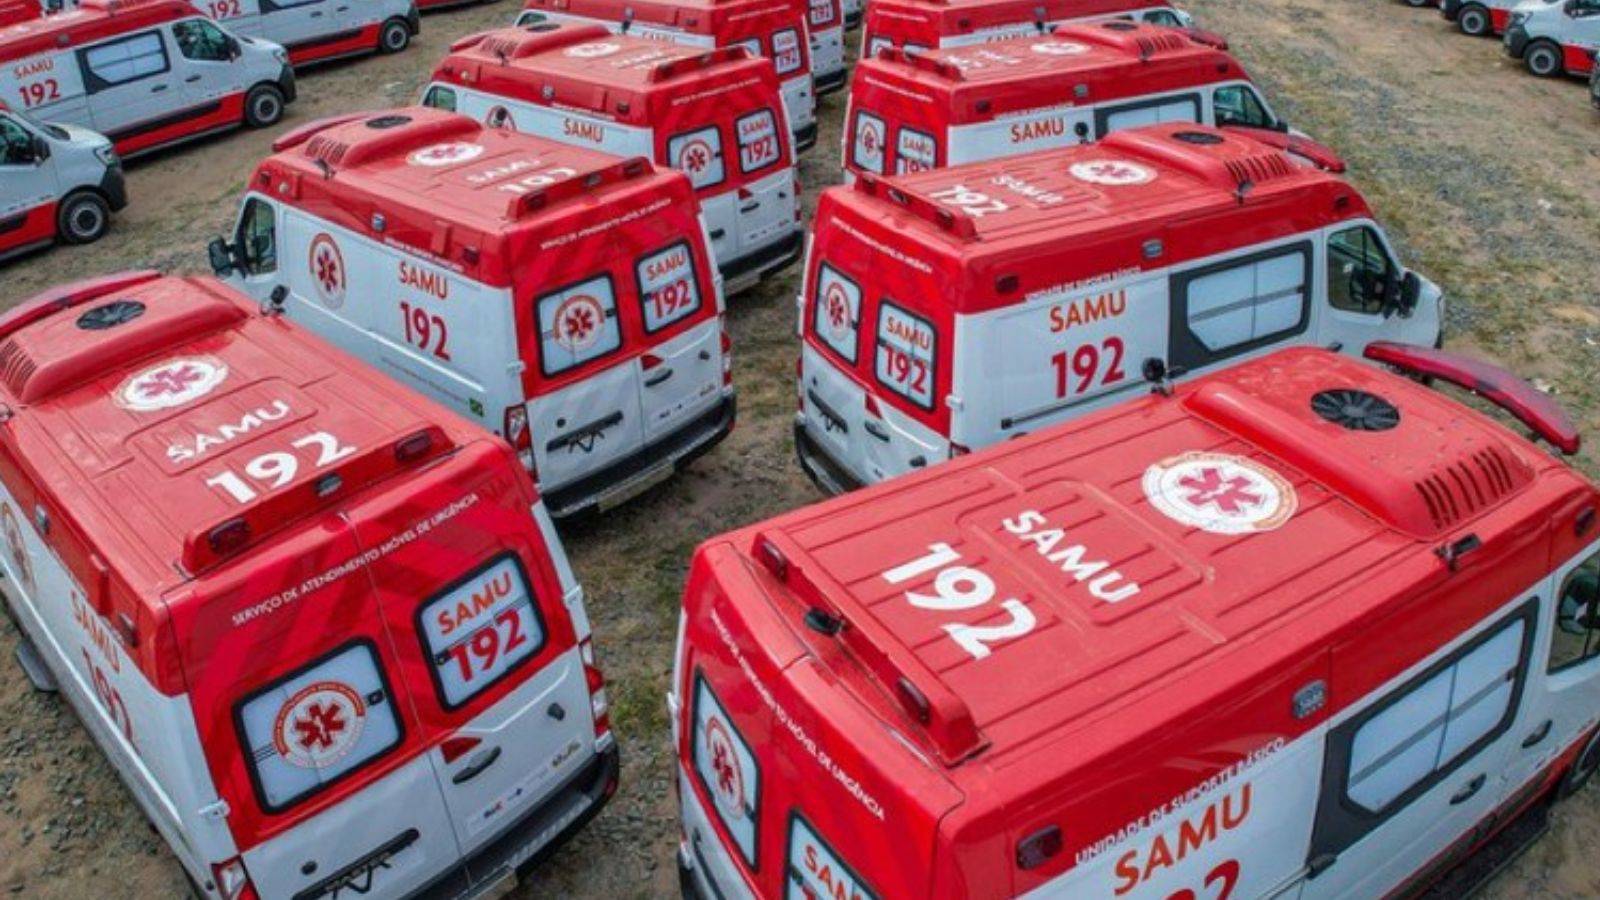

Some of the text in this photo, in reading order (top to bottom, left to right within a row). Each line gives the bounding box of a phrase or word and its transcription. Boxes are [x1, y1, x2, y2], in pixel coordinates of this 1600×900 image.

[208, 0, 242, 20] 192
[14, 58, 55, 80] SAMU
[19, 79, 61, 107] 192
[563, 117, 604, 143] SAMU
[746, 135, 774, 163] 192
[1010, 116, 1065, 143] SAMU
[928, 184, 1009, 217] 192
[398, 260, 448, 299] SAMU
[646, 255, 687, 281] SAMU
[651, 281, 692, 318] 192
[1049, 287, 1127, 333] SAMU
[400, 301, 451, 361] 192
[885, 316, 930, 351] SAMU
[884, 345, 927, 395] 192
[1051, 335, 1126, 399] 192
[166, 399, 290, 463] SAMU
[204, 431, 358, 504] 192
[282, 587, 299, 604] DE
[300, 548, 380, 594] ATENDIMENTO
[380, 529, 417, 556] MÓVEL
[415, 519, 432, 535] DE
[431, 492, 480, 527] URGÊNCIA
[1002, 509, 1141, 603] SAMU
[436, 571, 512, 636] SAMU
[880, 541, 1037, 660] 192
[70, 590, 120, 674] SAMU
[448, 608, 527, 682] 192
[1075, 735, 1286, 865] UNIDADE DE SUPORTE BÁSICO
[1113, 780, 1252, 897] SAMU
